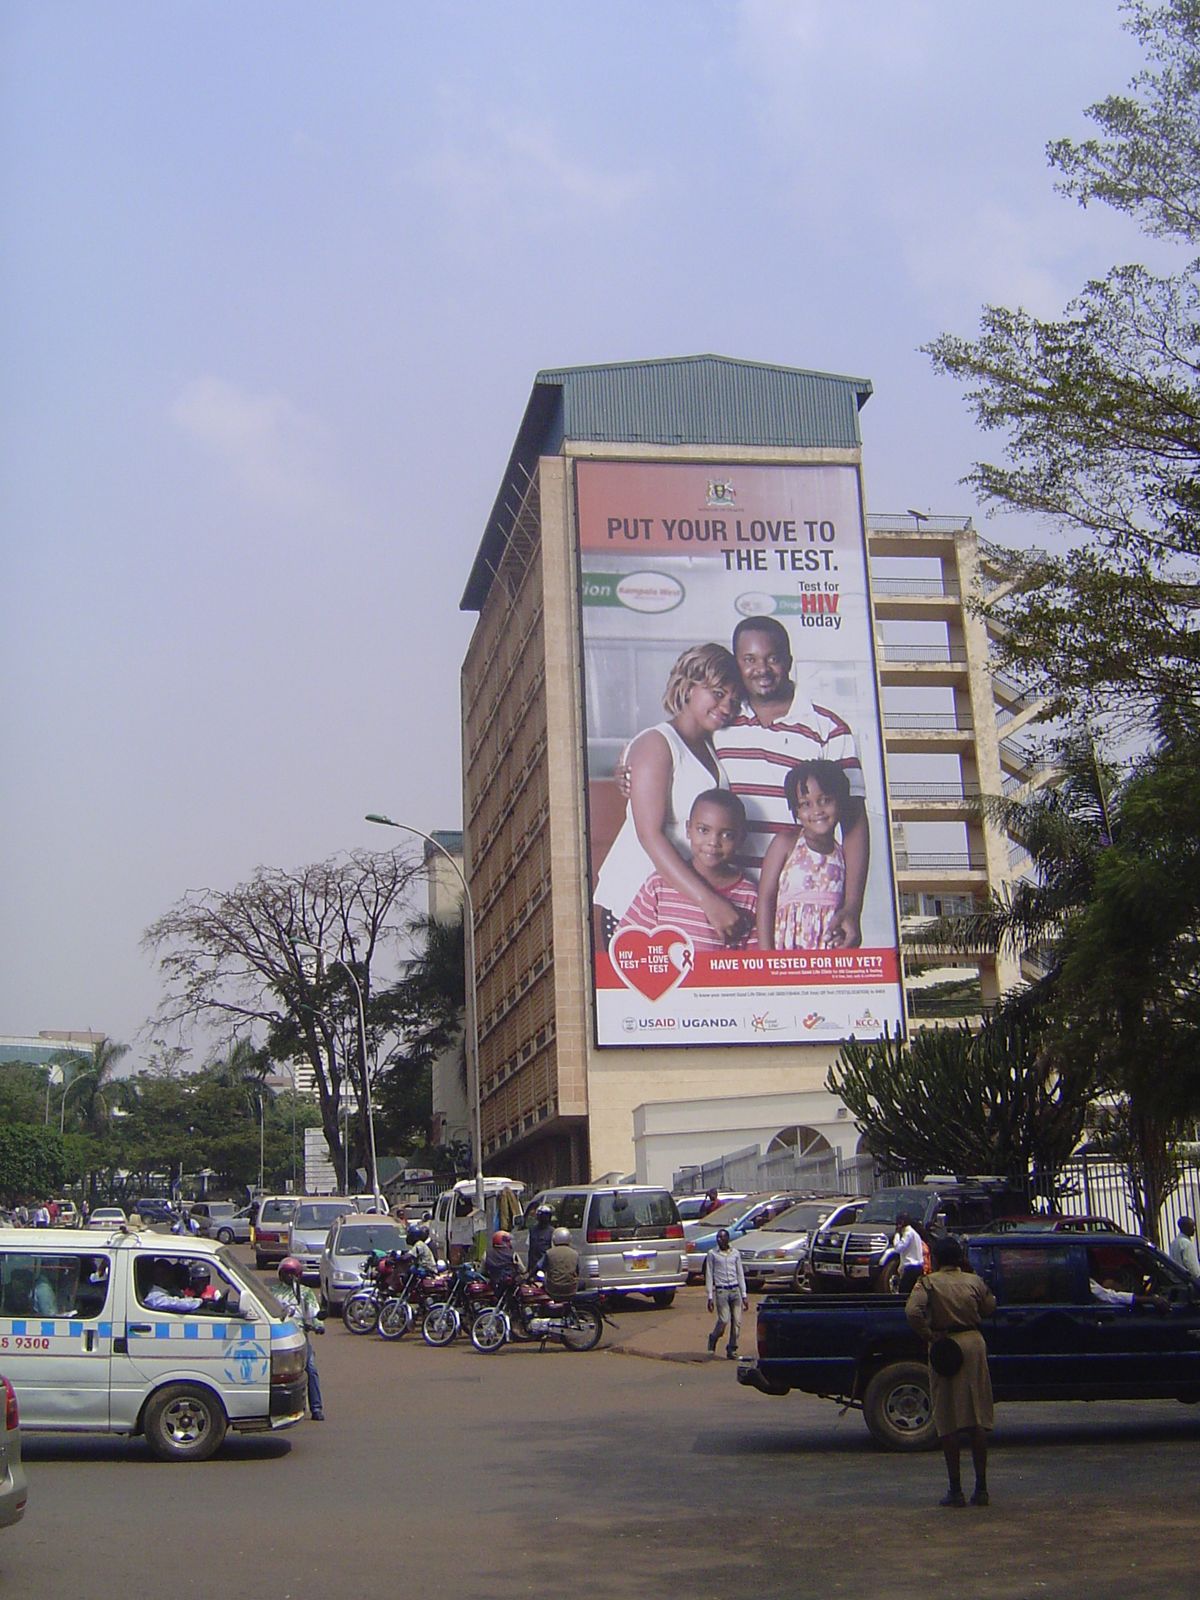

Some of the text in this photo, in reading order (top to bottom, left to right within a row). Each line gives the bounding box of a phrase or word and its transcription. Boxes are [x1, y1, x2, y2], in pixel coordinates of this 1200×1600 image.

[607, 517, 836, 543] PUT YOUR LOVE TO
[721, 549, 838, 571] THE TEST.
[582, 581, 611, 597] ion
[798, 581, 839, 592] Test for
[800, 593, 840, 614] HIV
[800, 613, 842, 630] today
[648, 945, 664, 954] THE
[619, 951, 633, 960] HIV
[648, 955, 670, 964] LOVE
[619, 960, 640, 969] TEST
[710, 956, 883, 970] HAVE YOU TESTED FOR HIV YET?
[649, 964, 670, 974] TEST
[639, 1018, 676, 1028] USAID
[682, 1018, 738, 1028] UGANDA
[855, 1019, 880, 1027] KCCA
[15, 1337, 50, 1350] 930Q
